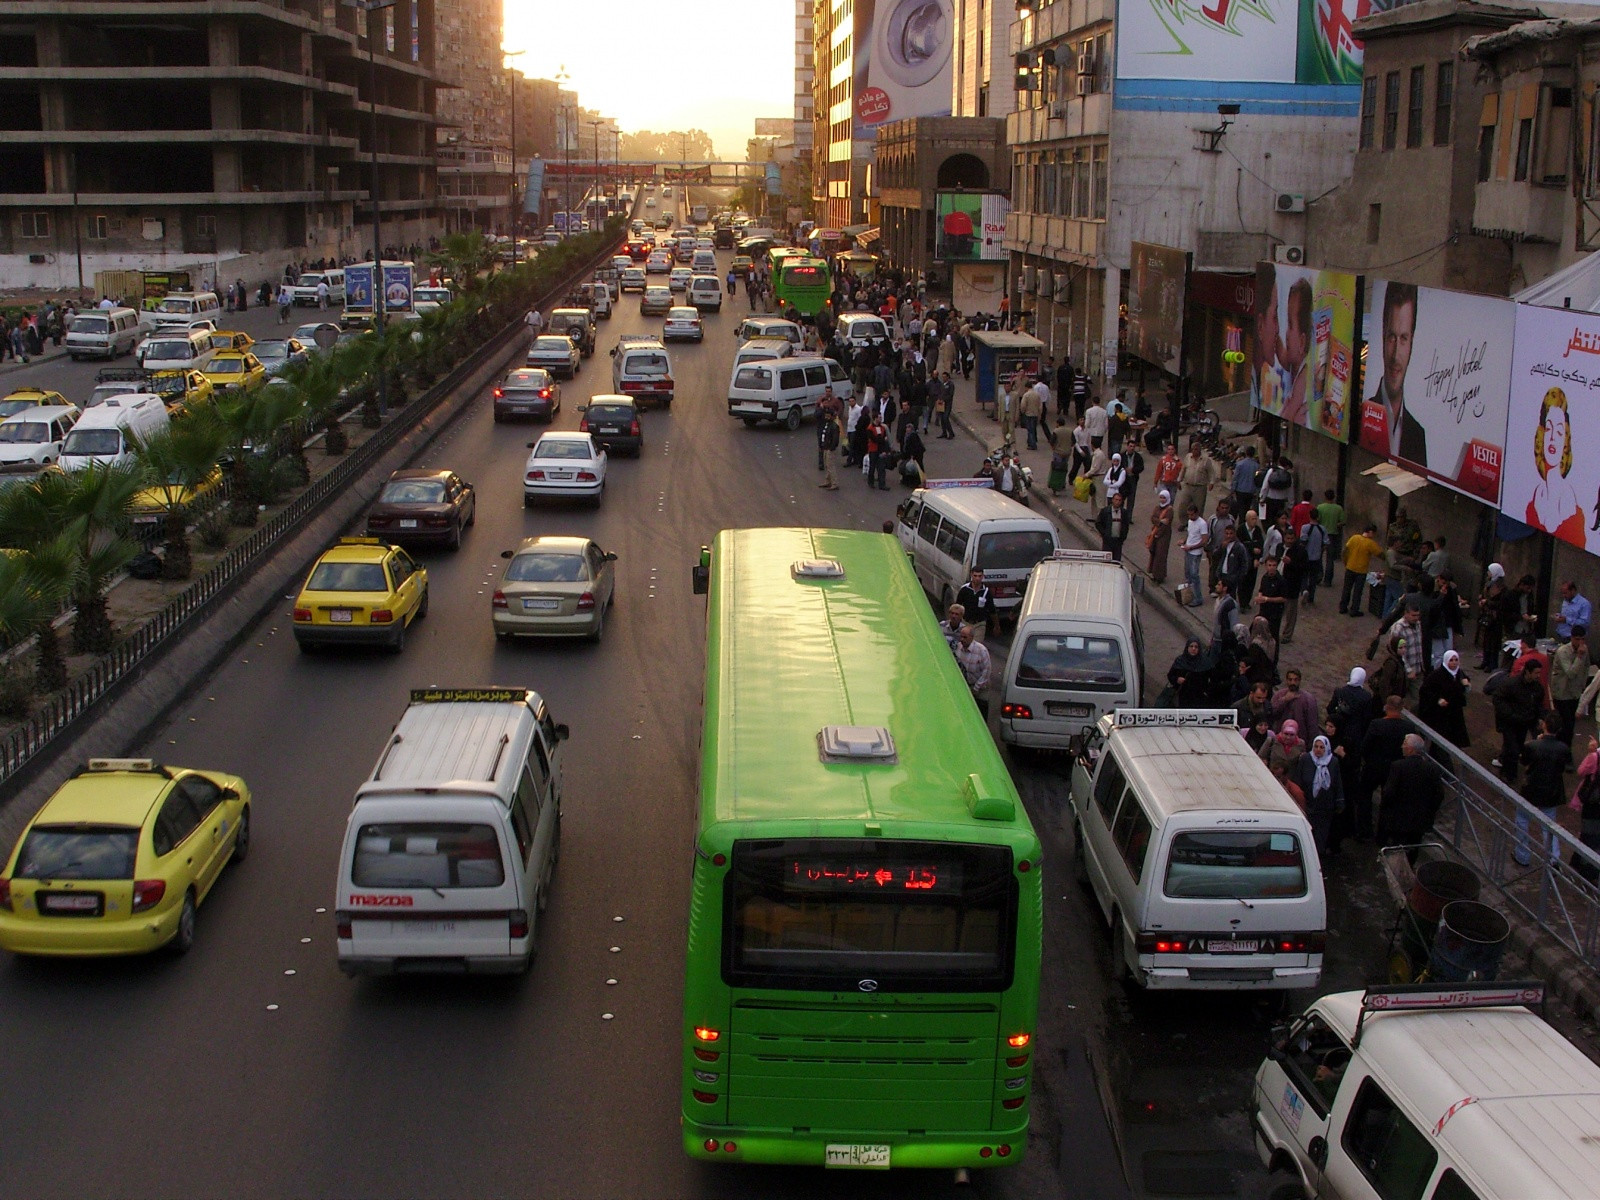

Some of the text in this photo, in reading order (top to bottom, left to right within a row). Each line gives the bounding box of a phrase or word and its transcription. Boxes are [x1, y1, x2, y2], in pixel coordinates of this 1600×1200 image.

[1424, 338, 1487, 403] Happy Vestel
[1457, 385, 1480, 424] you
[1472, 443, 1499, 467] VESTEL
[1165, 461, 1176, 471] 27
[1137, 713, 1158, 725] الثورة
[1391, 992, 1456, 1007] البلد
